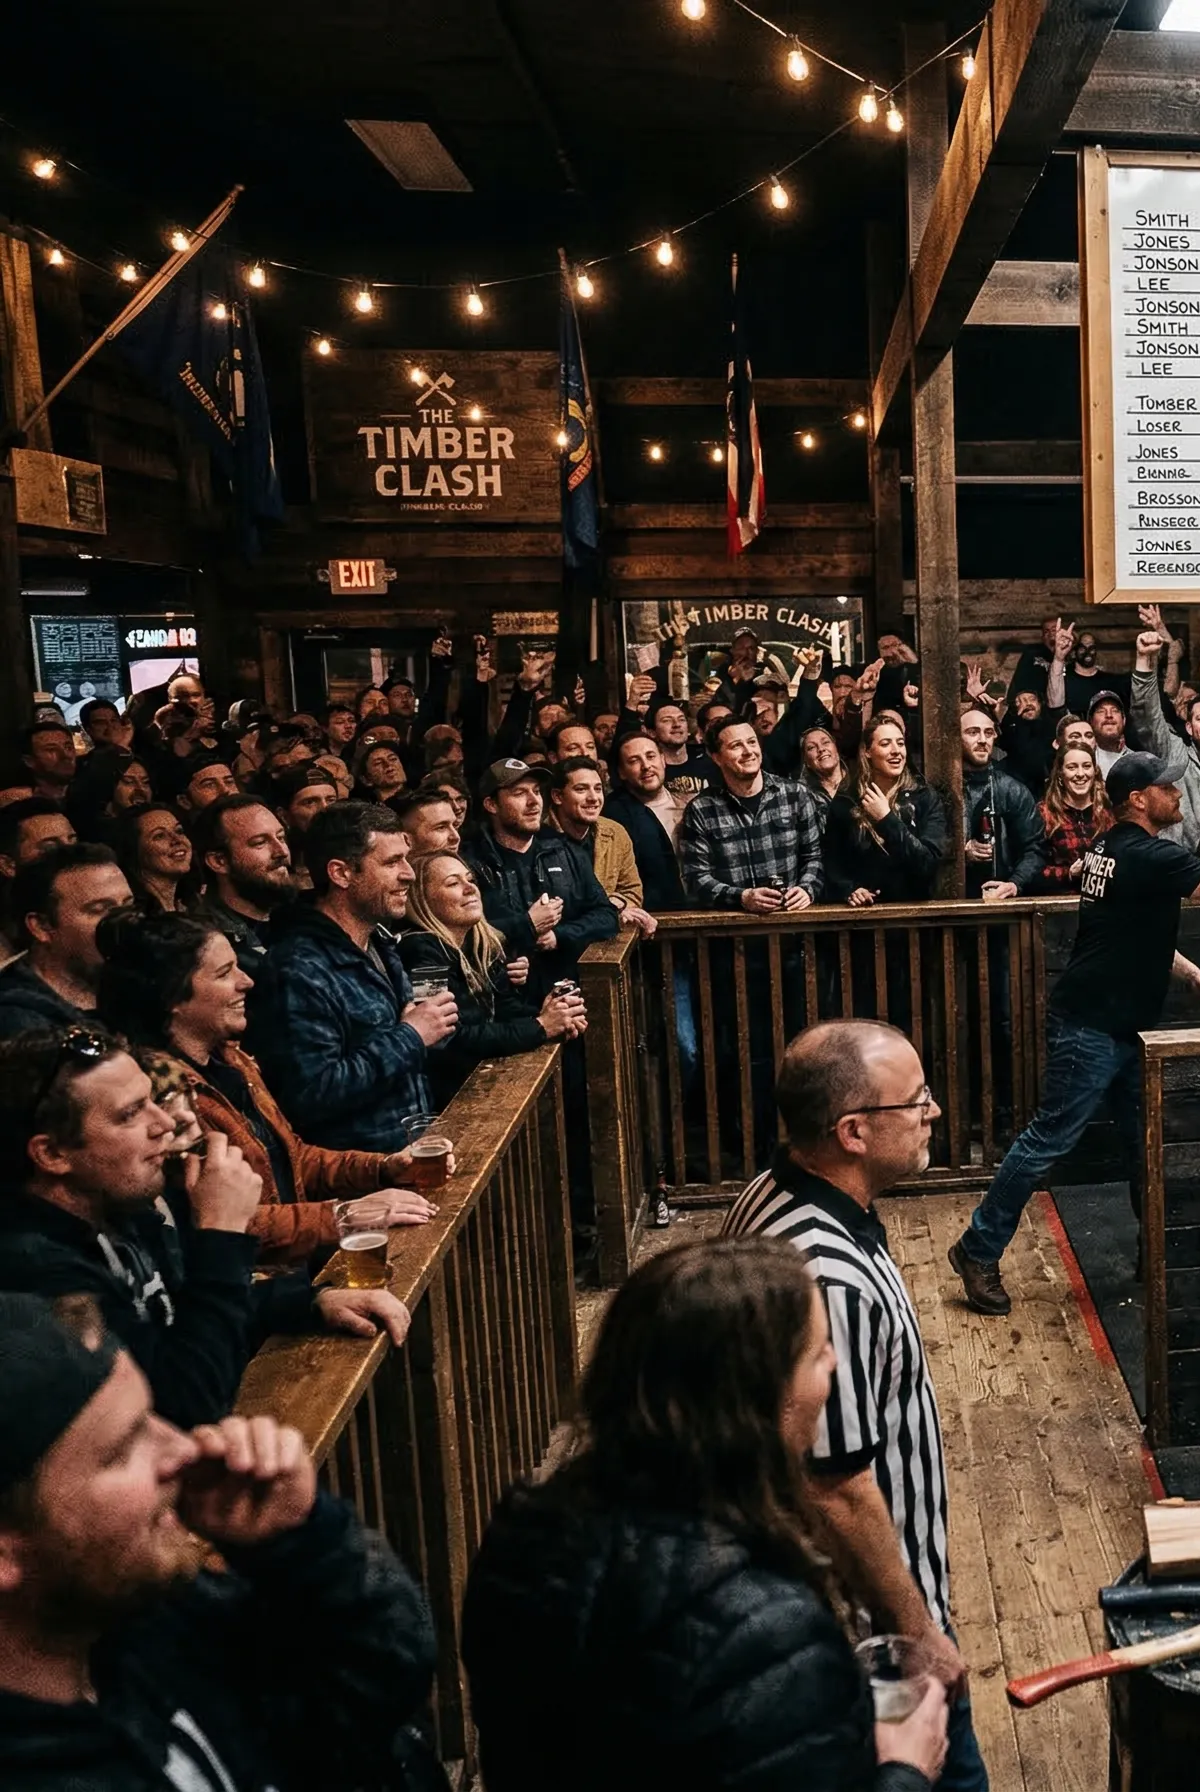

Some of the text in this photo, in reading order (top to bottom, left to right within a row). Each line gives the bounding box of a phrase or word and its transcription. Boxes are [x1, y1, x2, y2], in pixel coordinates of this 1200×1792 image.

[1135, 210, 1189, 228] SMITH
[1133, 233, 1190, 249] JONES
[1134, 255, 1199, 271] JONSON
[1137, 277, 1170, 291] LEE
[1135, 297, 1200, 314] JONSON
[1137, 318, 1189, 335] SMITH
[1136, 340, 1199, 355] JONSON
[1141, 362, 1173, 375] LEE
[417, 408, 455, 424] THE
[1137, 418, 1183, 433] LOSER
[357, 426, 516, 460] TIMBER
[1135, 443, 1179, 459] JONES
[375, 464, 503, 497] CLASH
[1135, 538, 1192, 552] JONNES
[337, 560, 375, 588] EXIT
